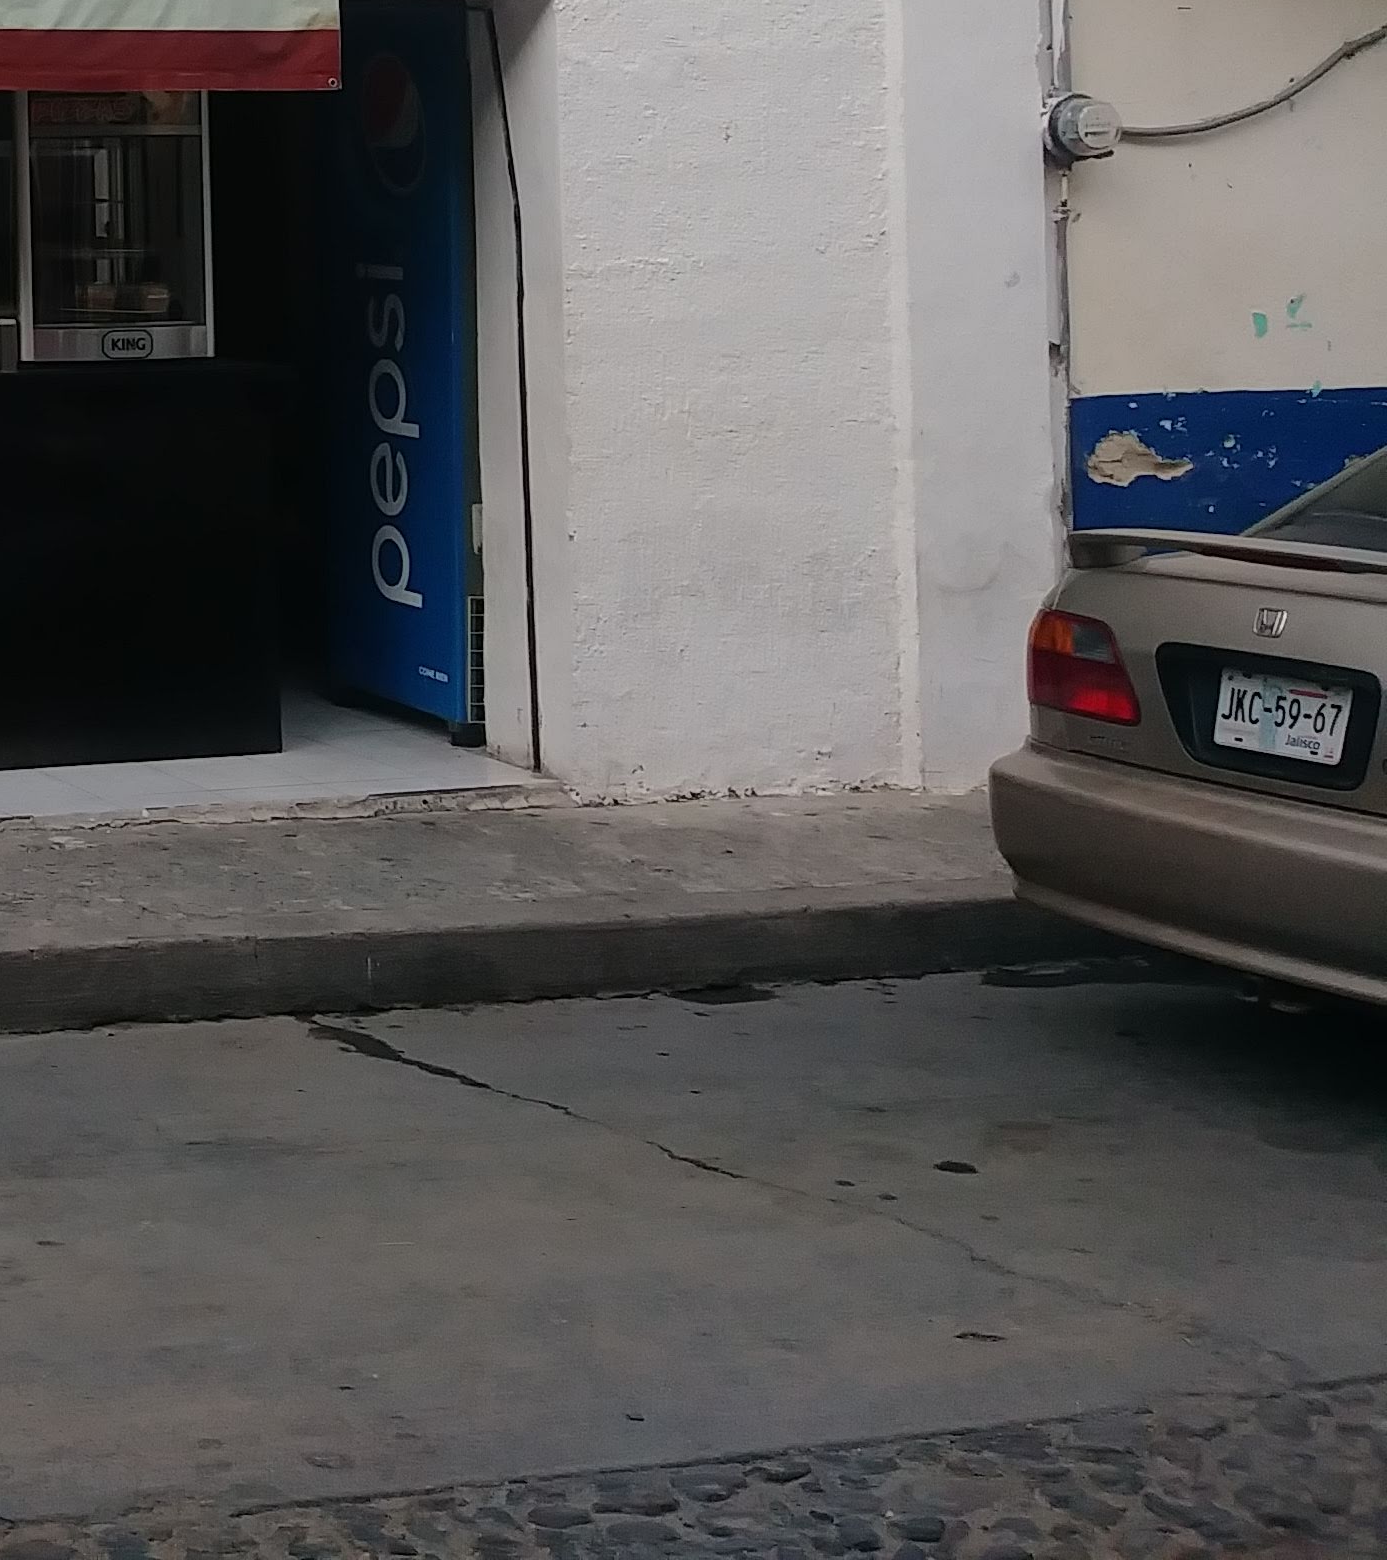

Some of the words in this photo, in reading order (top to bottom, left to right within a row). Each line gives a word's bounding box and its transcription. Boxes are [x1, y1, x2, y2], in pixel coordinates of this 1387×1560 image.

[111, 337, 146, 351] KING
[355, 262, 422, 608] pepsi
[1221, 687, 1342, 737] JKC-59-67
[1285, 734, 1321, 751] Jalisco
